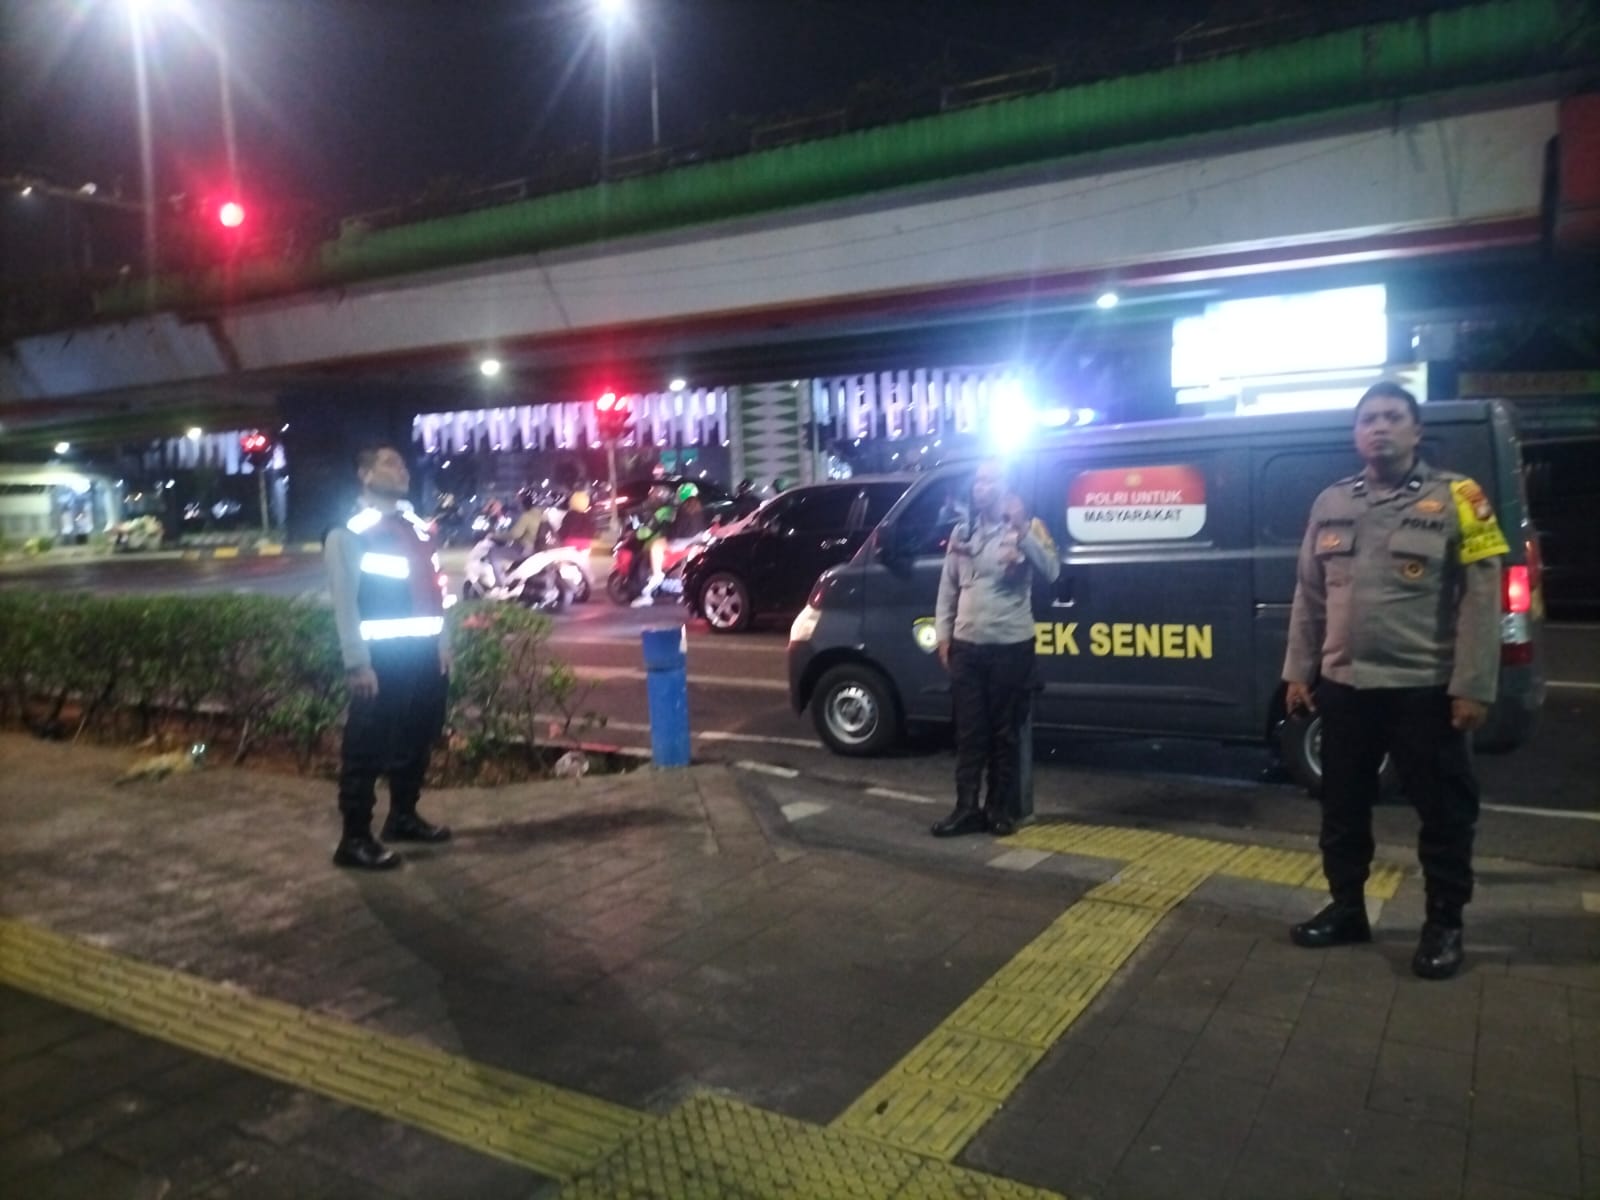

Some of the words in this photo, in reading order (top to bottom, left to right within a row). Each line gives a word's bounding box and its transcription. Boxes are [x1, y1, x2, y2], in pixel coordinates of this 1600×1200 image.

[1085, 491, 1128, 505] POLRI
[1131, 489, 1183, 504] UNTUK
[1084, 508, 1183, 522] MASYARAKAT
[1089, 622, 1212, 659] SENEN
